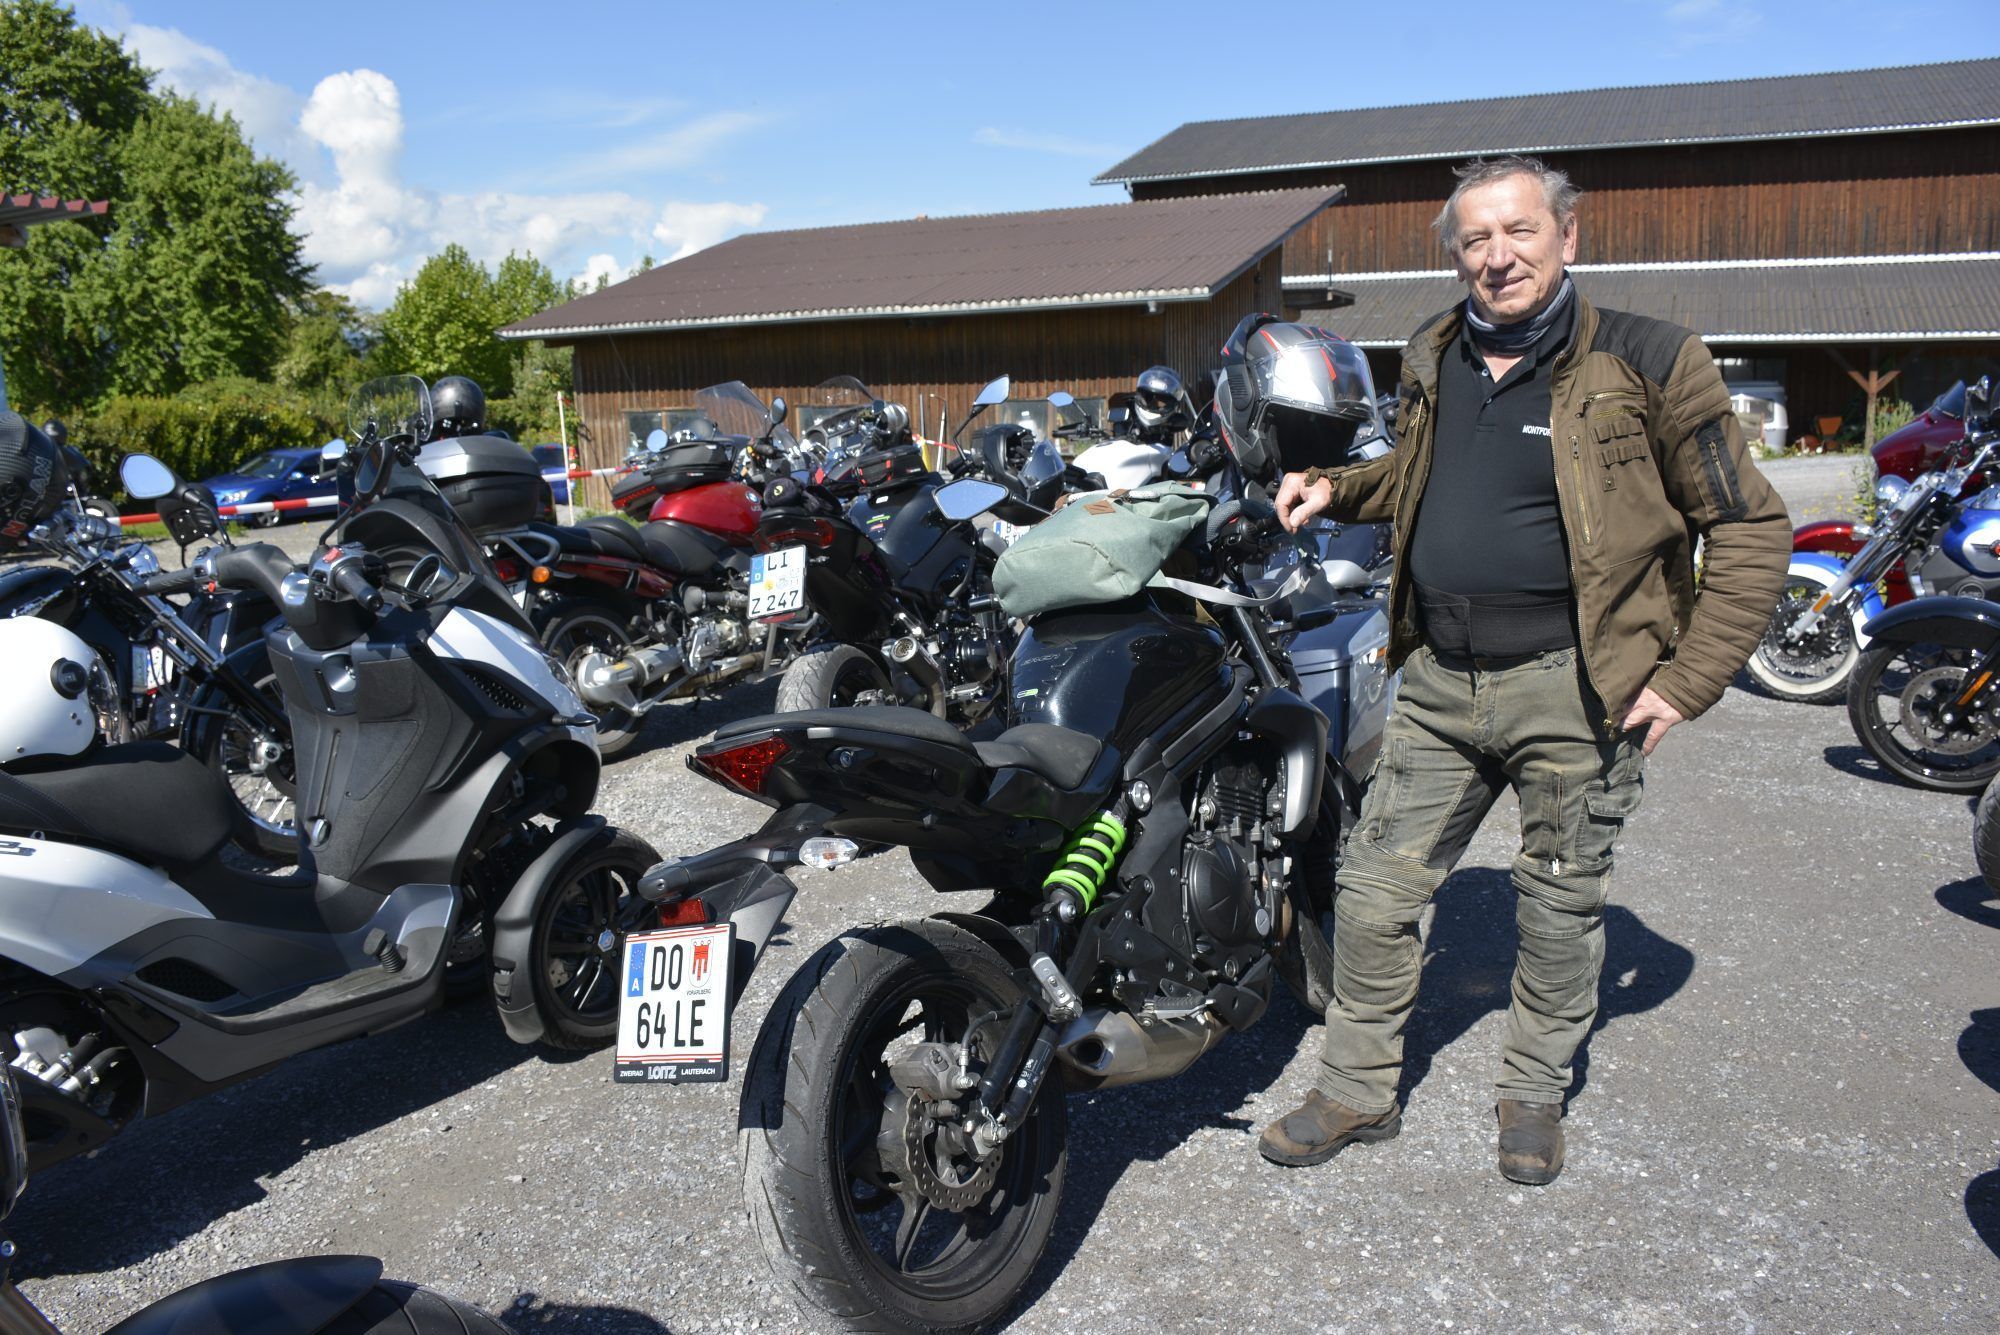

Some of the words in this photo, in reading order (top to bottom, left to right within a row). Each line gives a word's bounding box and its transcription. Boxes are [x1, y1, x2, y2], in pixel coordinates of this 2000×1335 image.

[1, 456, 53, 537] NOLAN
[767, 552, 788, 571] LI
[752, 598, 761, 614] Z
[766, 589, 799, 612] 247
[651, 944, 683, 990] DO
[631, 977, 640, 992] A
[648, 1065, 677, 1080] LOITZ
